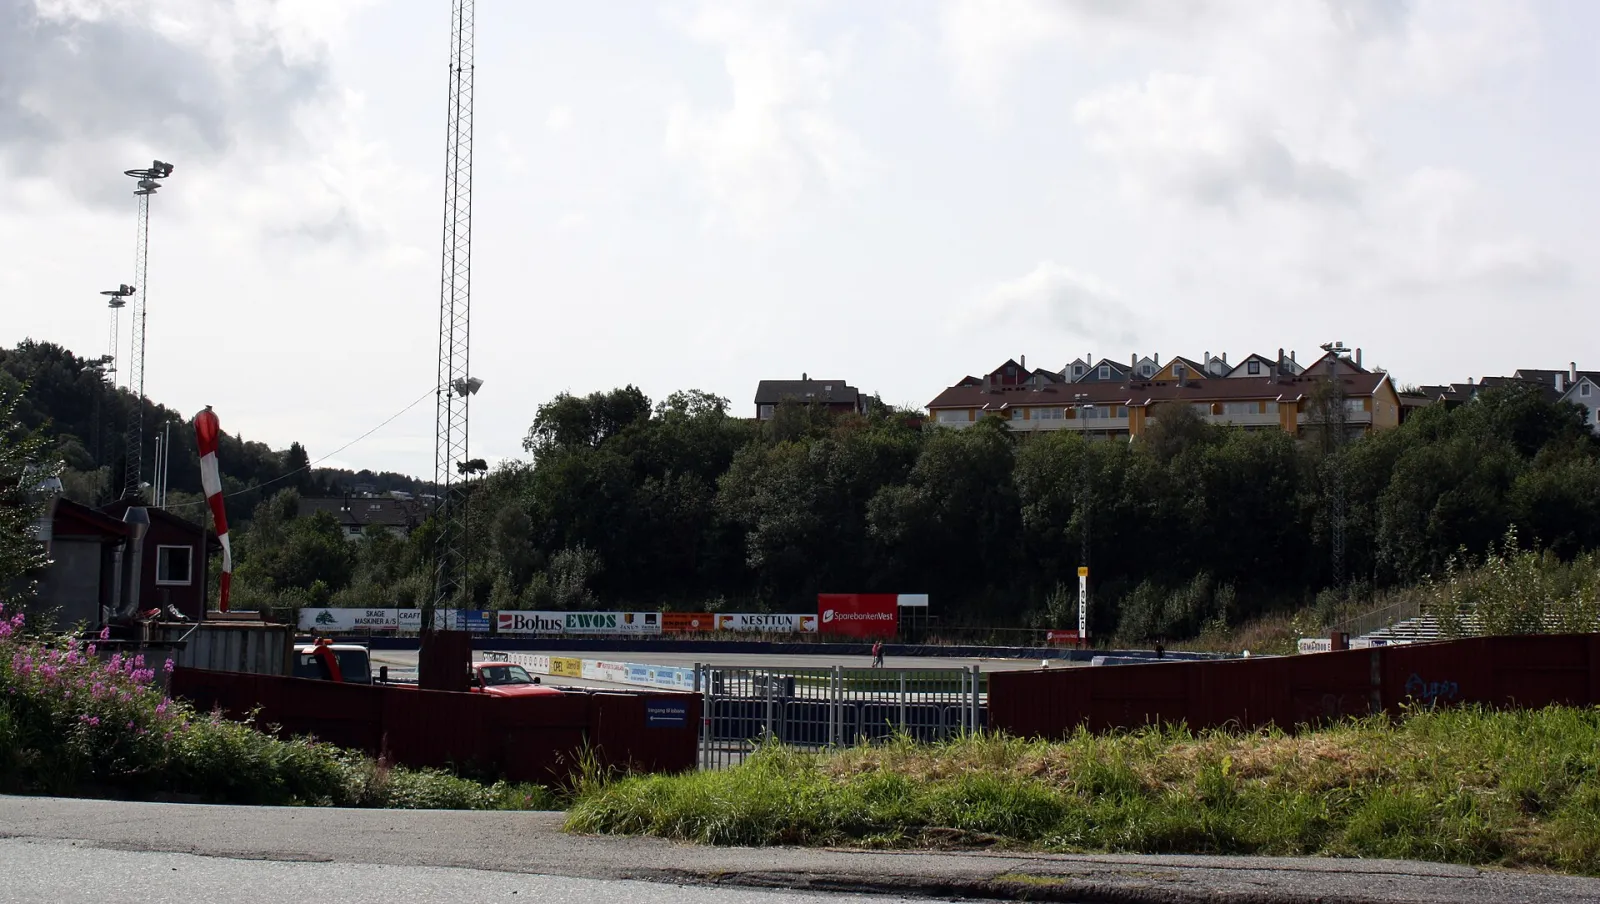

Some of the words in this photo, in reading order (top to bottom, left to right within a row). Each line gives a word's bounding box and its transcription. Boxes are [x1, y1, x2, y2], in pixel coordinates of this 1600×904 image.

[513, 614, 562, 630] Bohus
[565, 614, 617, 628] EWOS
[741, 615, 793, 625] NESTTUN
[834, 611, 893, 621] SparebankenVest
